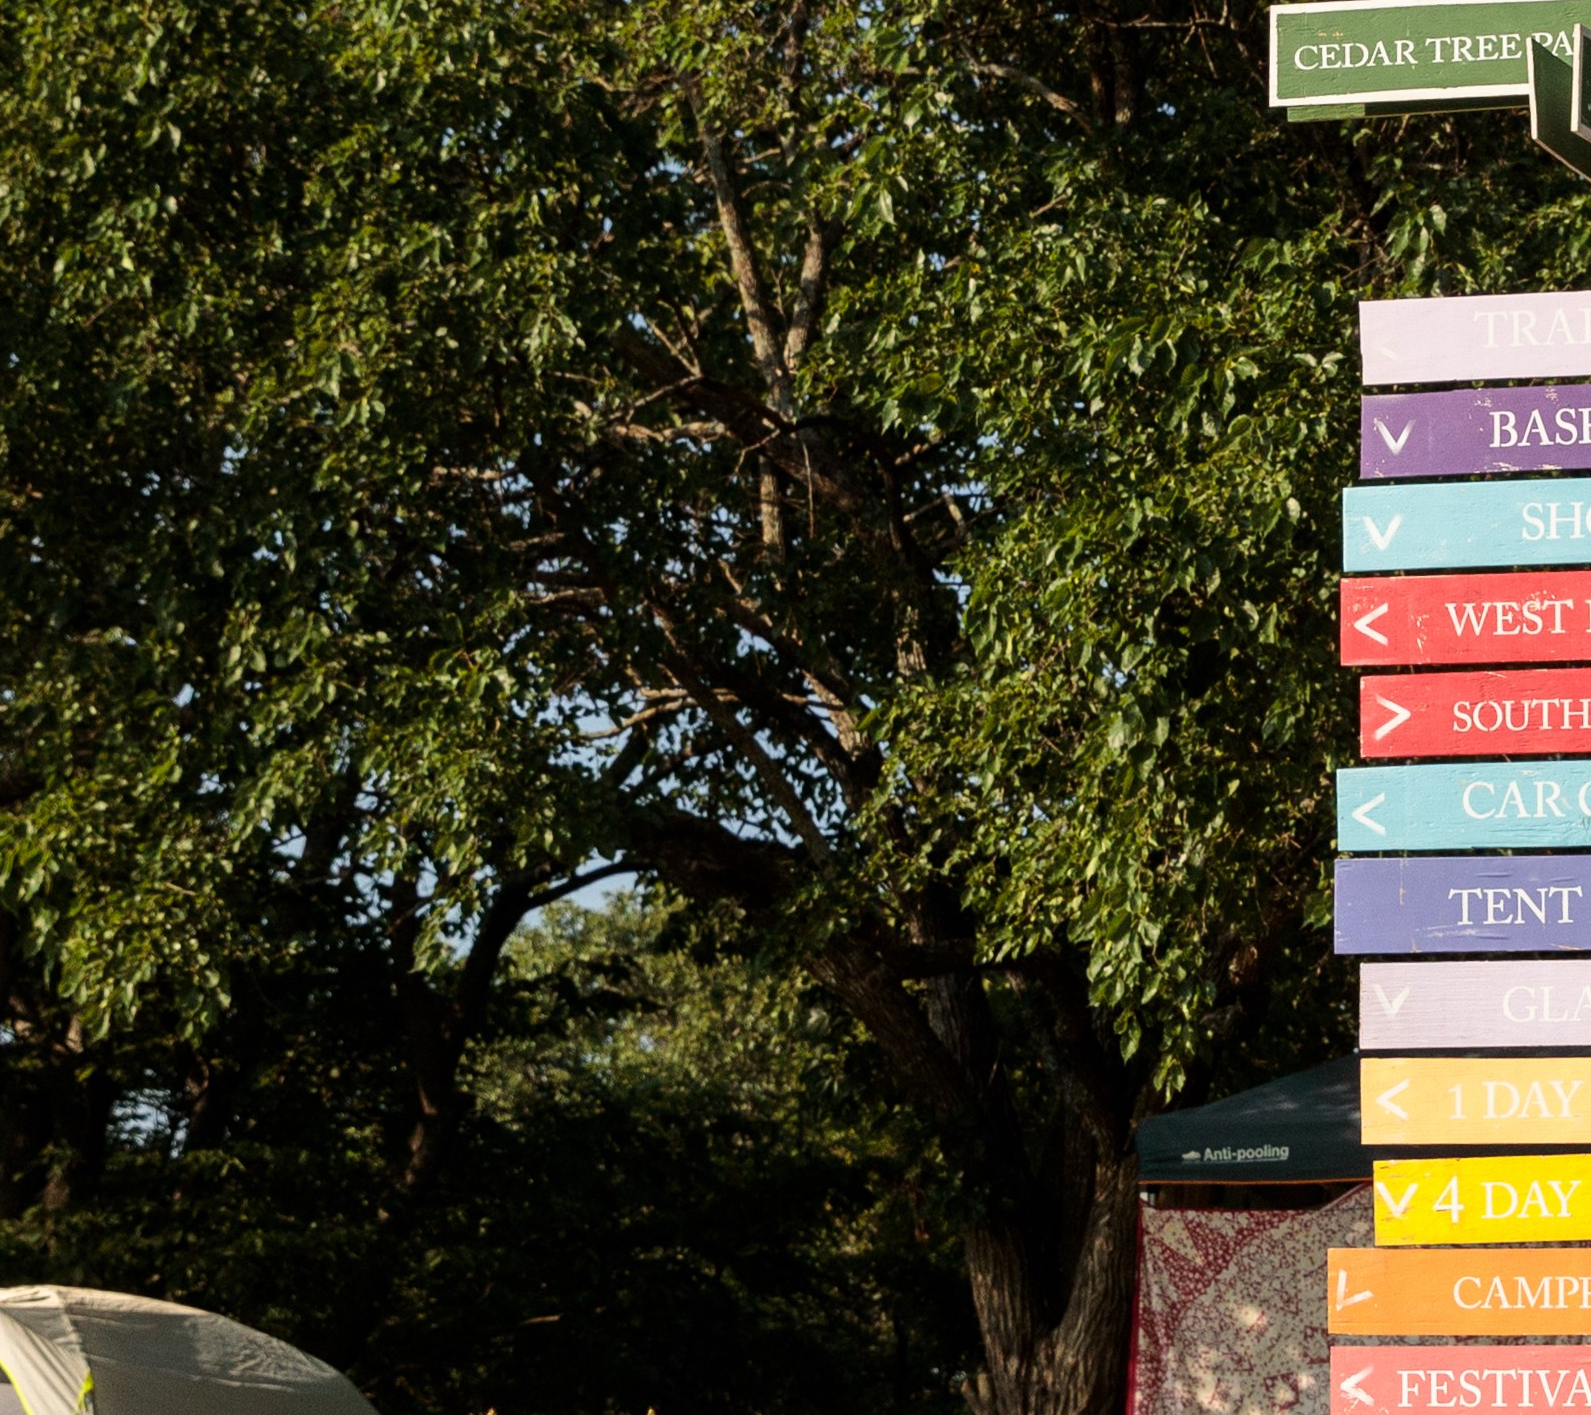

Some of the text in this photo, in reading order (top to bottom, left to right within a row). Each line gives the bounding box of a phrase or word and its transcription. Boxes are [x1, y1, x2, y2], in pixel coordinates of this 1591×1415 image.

[1294, 40, 1418, 71] CEDAR
[1425, 34, 1522, 64] TREE
[1445, 599, 1575, 637] WEST
[1452, 699, 1591, 733] SOUTH
[1461, 780, 1566, 820] CAR
[1448, 886, 1583, 927] TENT
[1448, 1084, 1467, 1121] 1
[1483, 1080, 1583, 1119] DAY
[1204, 1144, 1289, 1162] Anti-pooling
[1432, 1176, 1464, 1225] 4
[1481, 1179, 1582, 1219] DAY
